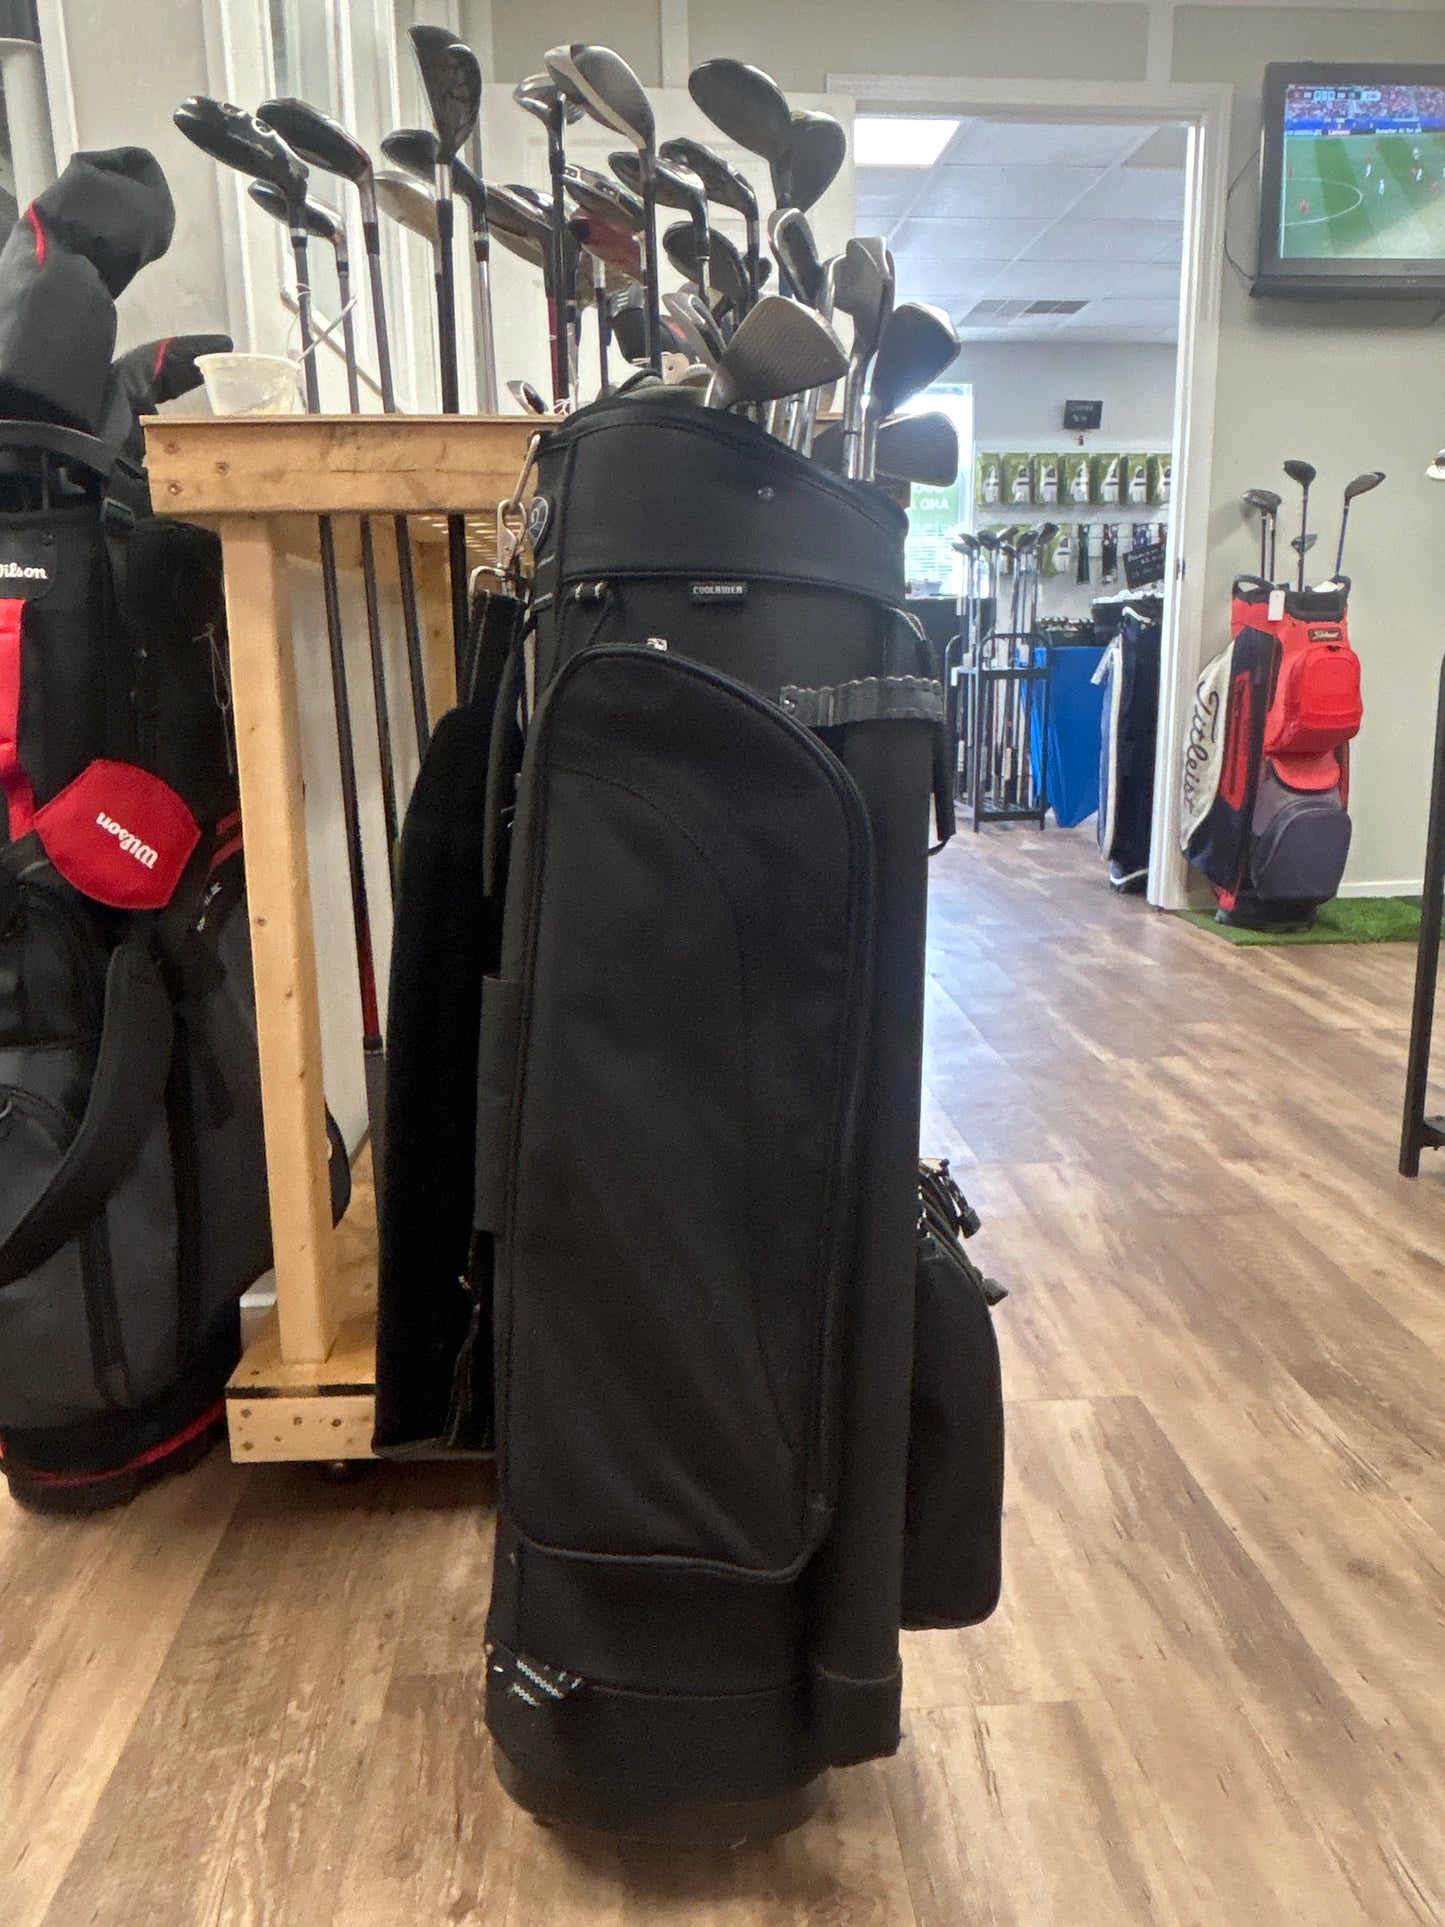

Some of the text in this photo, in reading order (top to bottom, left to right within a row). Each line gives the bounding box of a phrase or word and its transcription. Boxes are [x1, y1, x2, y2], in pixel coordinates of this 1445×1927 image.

[0, 562, 48, 579] ilson
[1183, 680, 1220, 814] Titleist
[95, 811, 159, 869] Wilson
